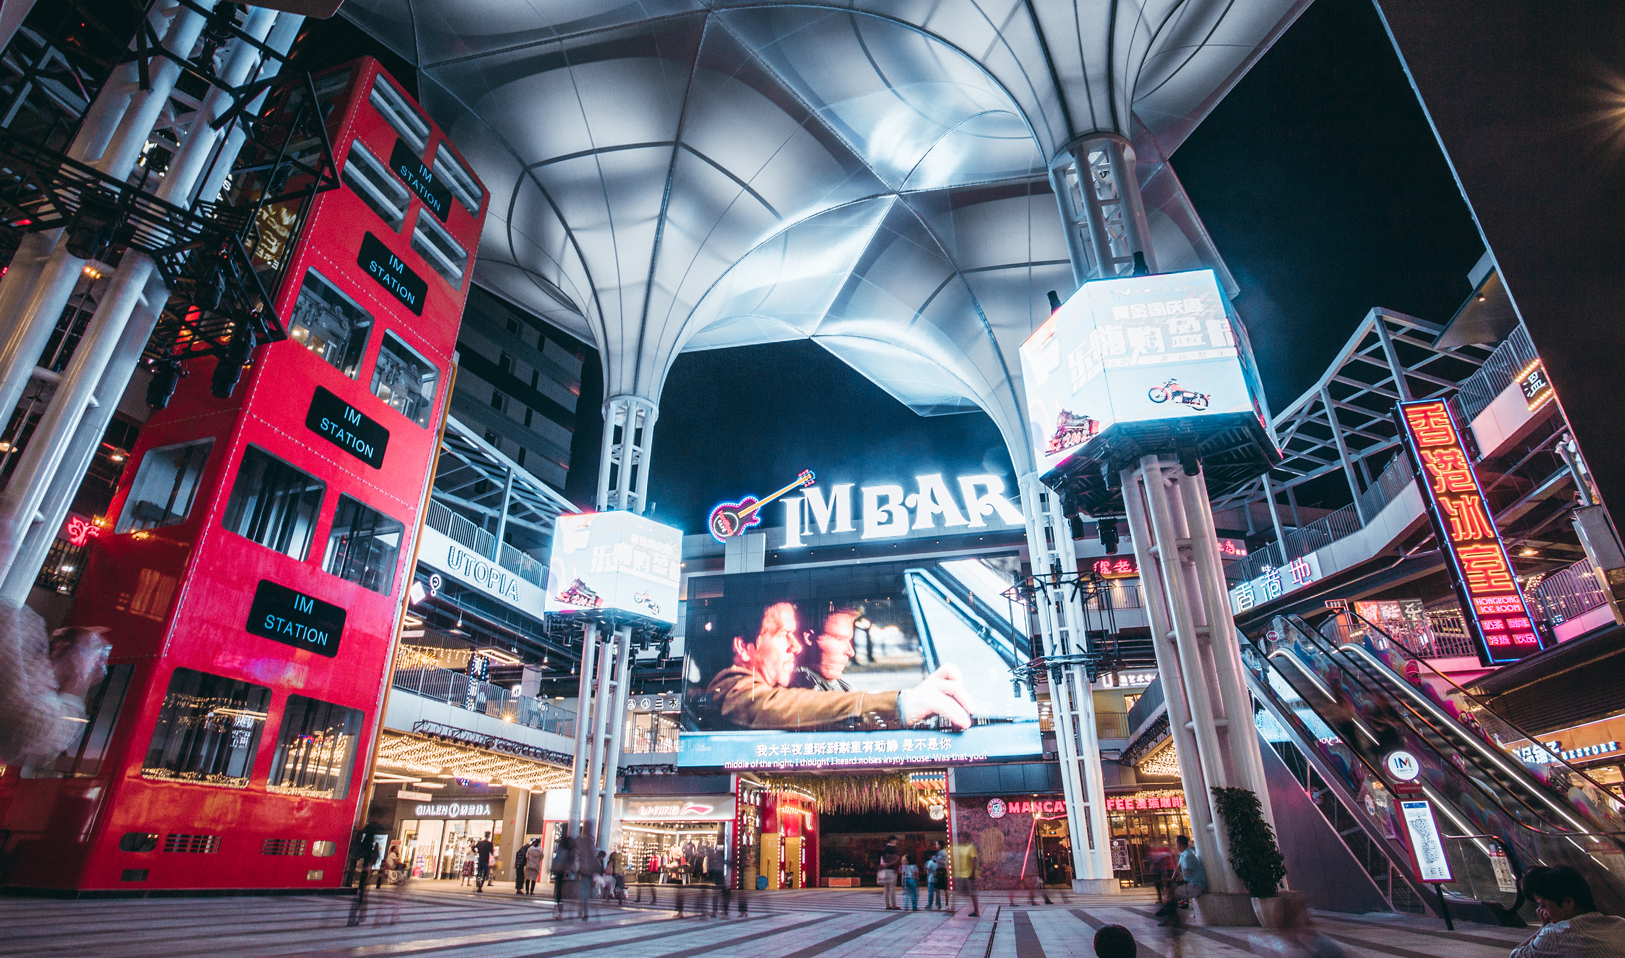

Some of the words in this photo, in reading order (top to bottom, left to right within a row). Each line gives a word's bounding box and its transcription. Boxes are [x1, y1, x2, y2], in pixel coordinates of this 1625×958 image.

[419, 164, 433, 183] IM
[400, 165, 441, 211] STATION
[389, 254, 404, 274] IM
[369, 260, 415, 305] STATION
[344, 406, 361, 427] IM
[320, 417, 374, 459] STATION
[1405, 403, 1515, 593] 香港冰室
[779, 483, 857, 549] IM
[860, 473, 1027, 540] BAR
[447, 545, 519, 602] UTOPIA
[1235, 556, 1313, 613] 香港地
[293, 594, 314, 615] IM
[1475, 596, 1520, 606] HONGKONG
[1495, 604, 1521, 612] ROOM
[264, 614, 329, 646] STATION
[1515, 633, 1537, 644] 饮品
[902, 737, 953, 751] 是不是你
[1561, 741, 1618, 761] BESTORE
[724, 759, 749, 769] middle
[750, 759, 759, 768] of
[760, 759, 771, 768] the
[773, 759, 794, 769] night,
[858, 756, 882, 764] noises
[906, 753, 931, 763] house.
[933, 753, 949, 762] Was
[951, 752, 967, 761] that
[969, 751, 988, 762] you?
[1393, 756, 1412, 769] IM
[638, 805, 679, 815] LI-NING
